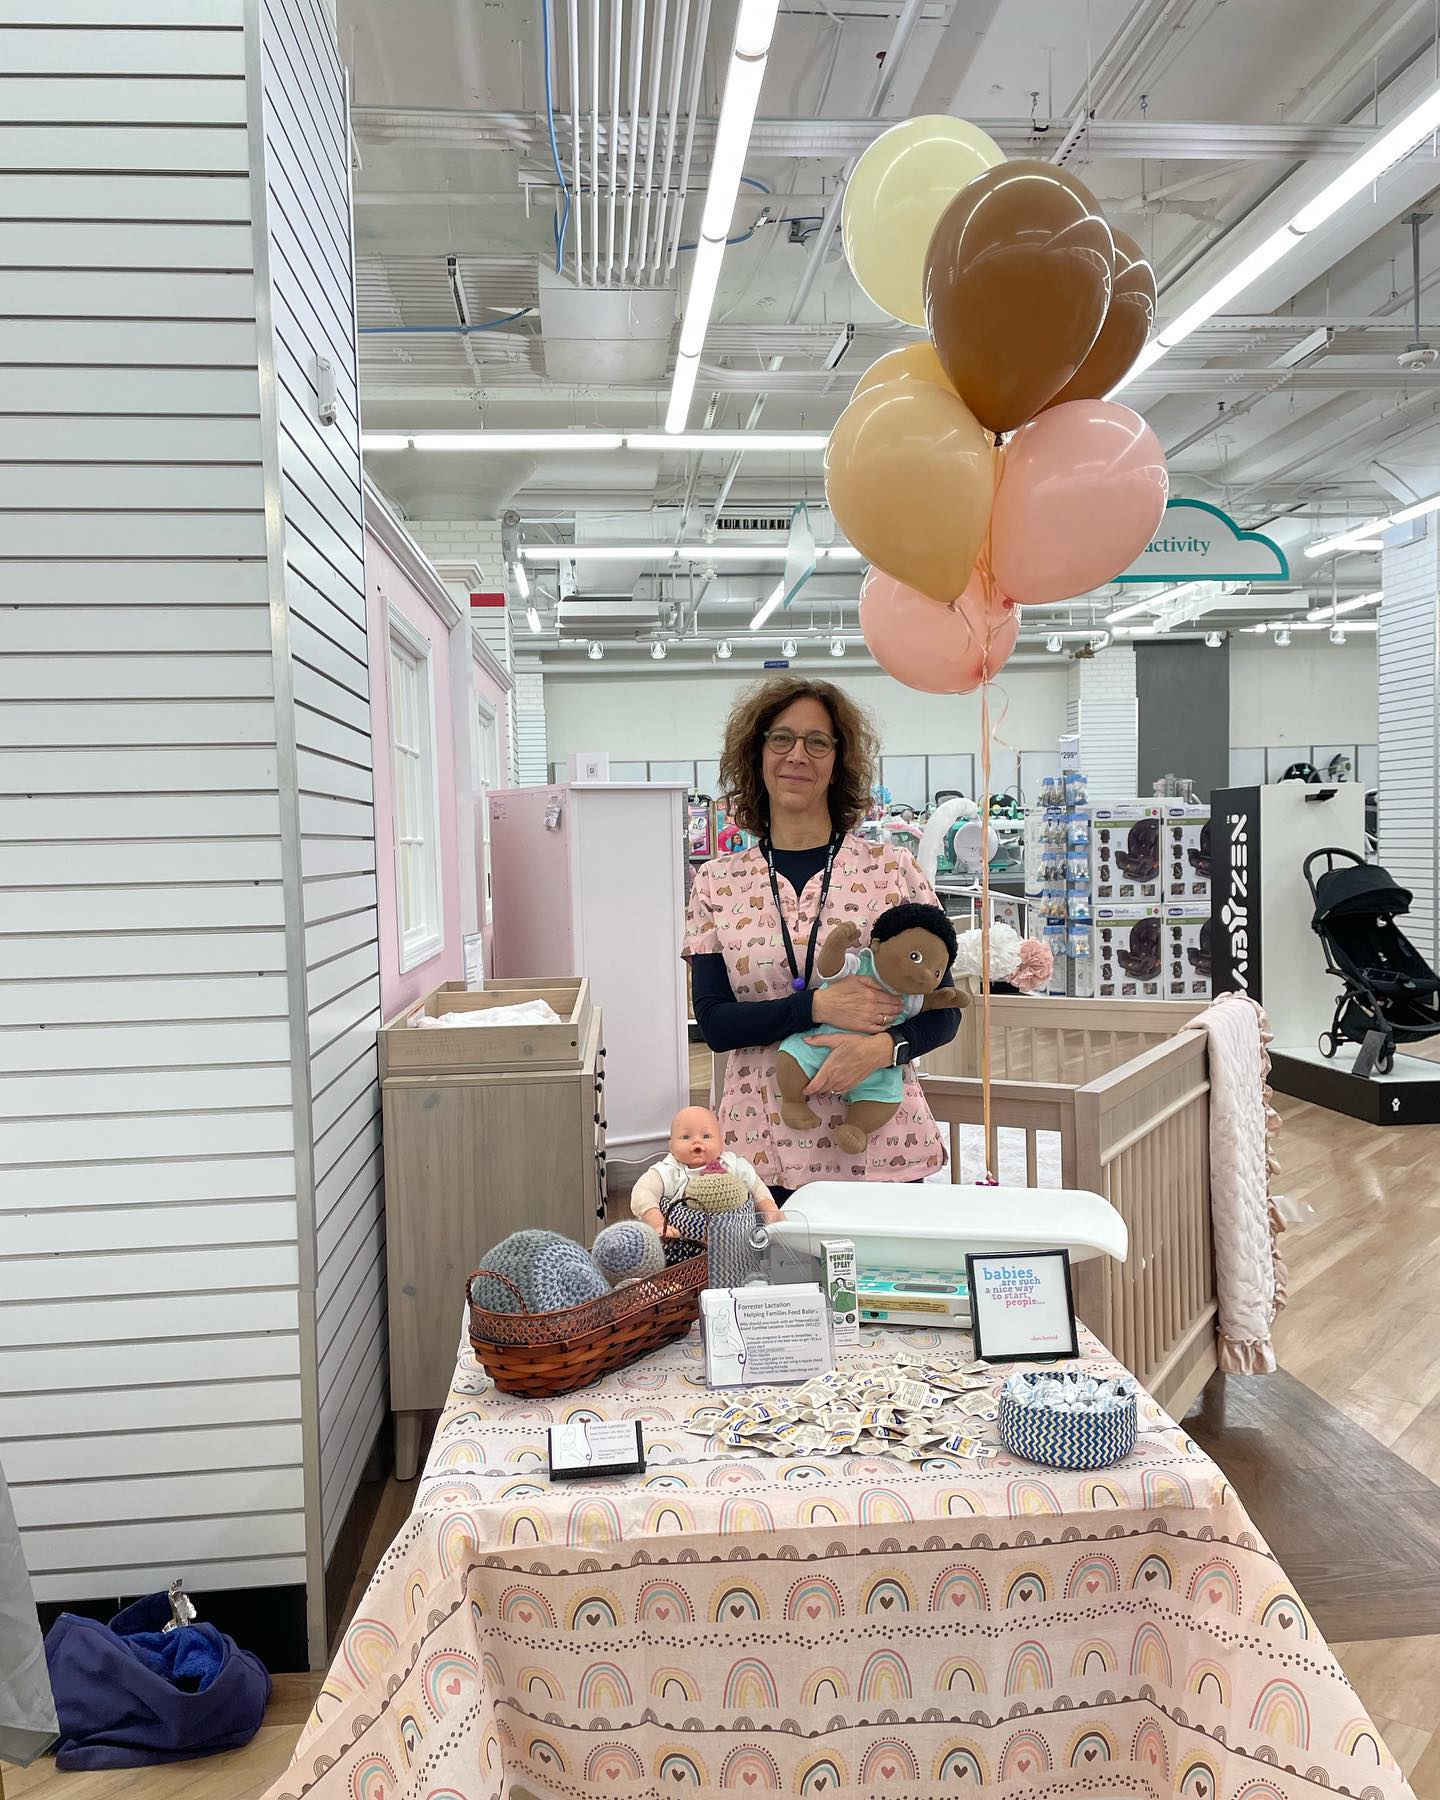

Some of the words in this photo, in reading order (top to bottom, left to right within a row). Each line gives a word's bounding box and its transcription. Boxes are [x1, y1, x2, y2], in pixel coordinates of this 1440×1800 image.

[833, 1261, 851, 1269] SPRAY
[983, 1266, 1033, 1280] babies
[1019, 1276, 1040, 1285] such
[993, 1285, 1013, 1293] nice
[1015, 1285, 1034, 1294] way
[1005, 1297, 1045, 1308] people...
